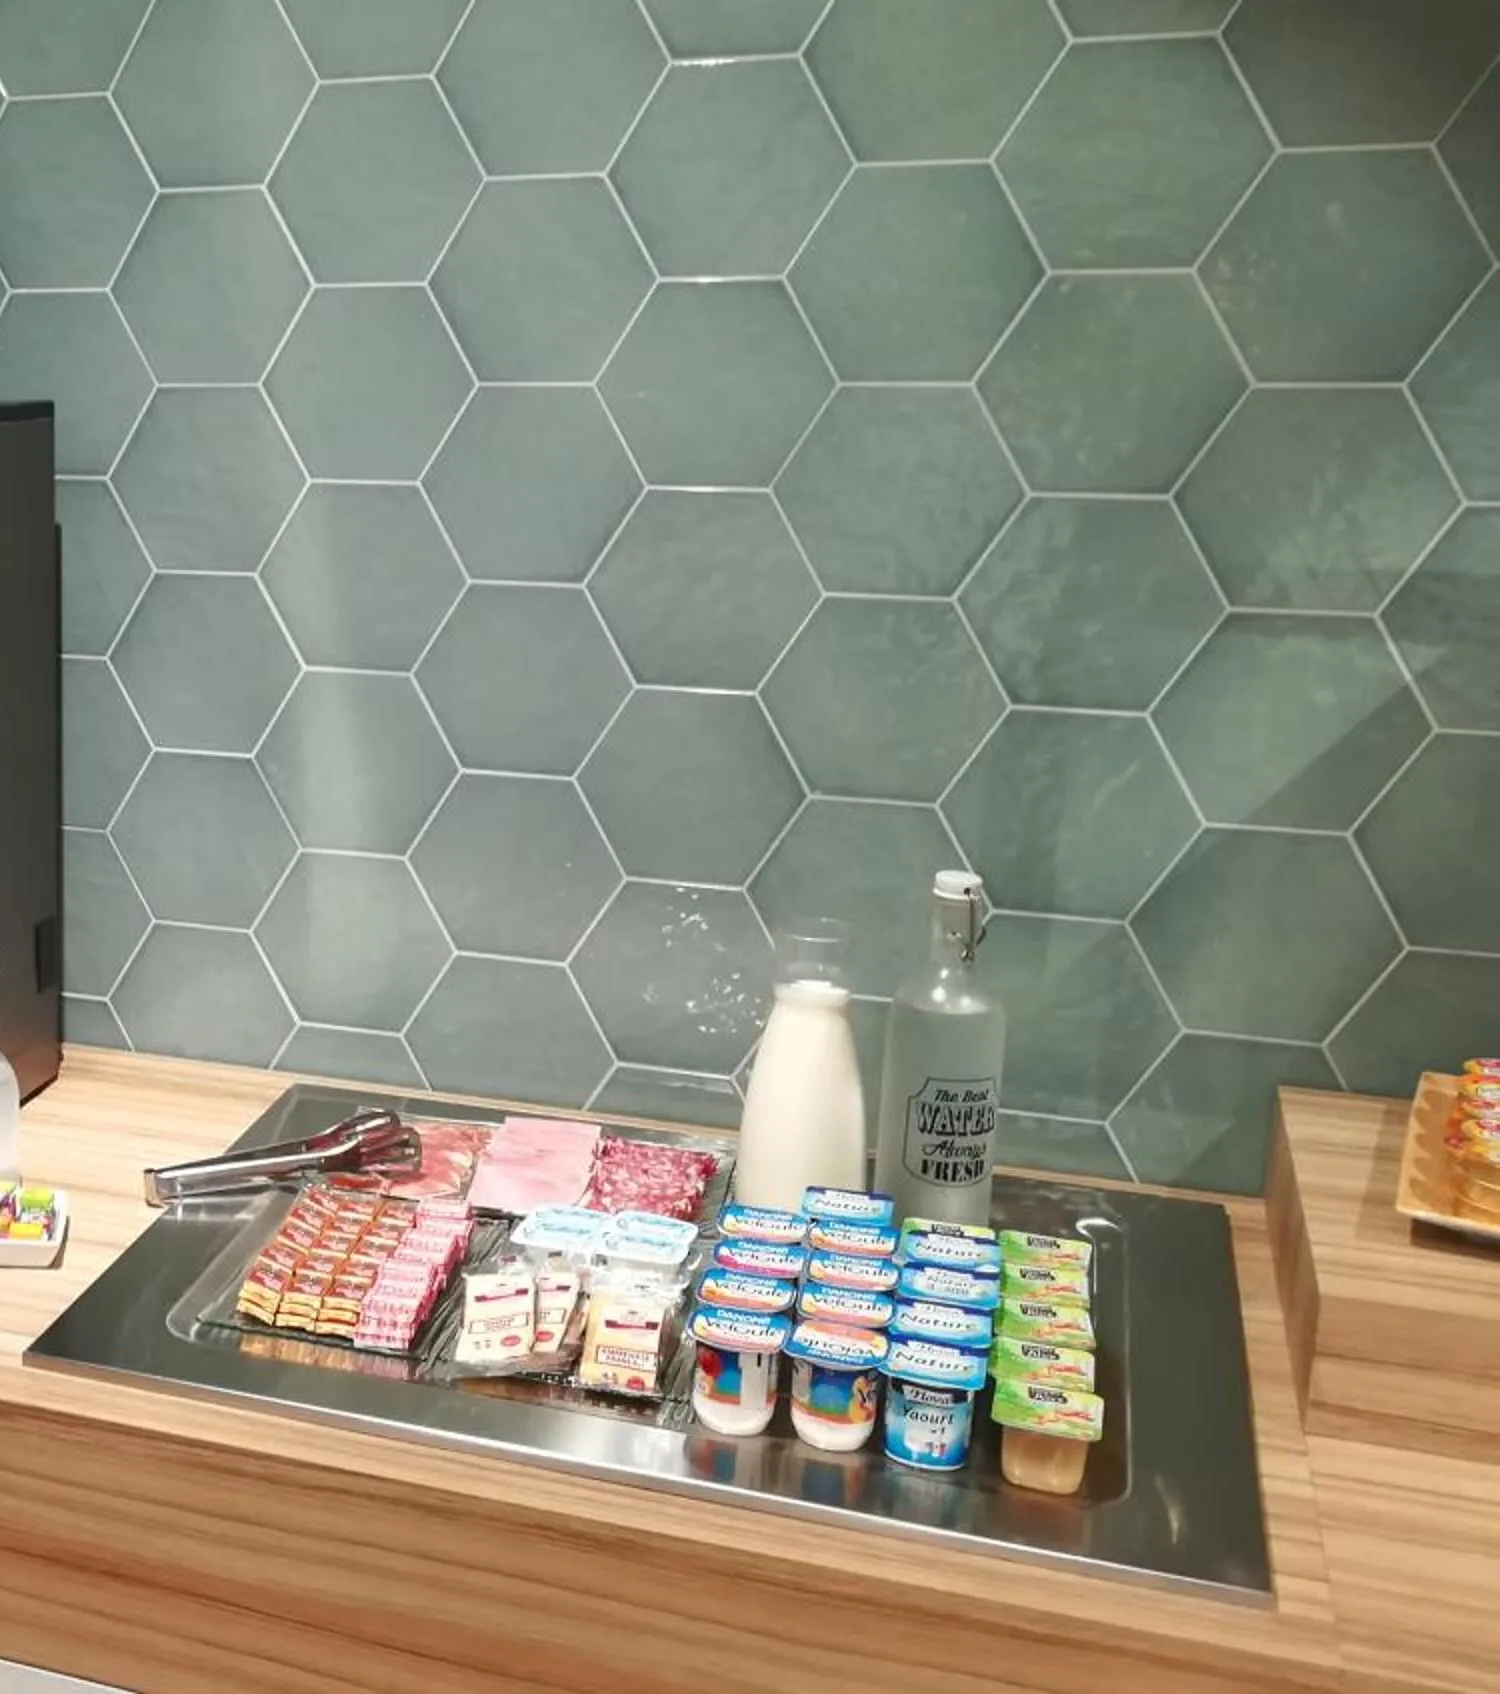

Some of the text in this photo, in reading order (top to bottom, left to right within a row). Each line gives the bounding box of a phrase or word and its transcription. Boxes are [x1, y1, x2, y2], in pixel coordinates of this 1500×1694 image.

[934, 1089, 958, 1102] The
[917, 1103, 995, 1136] WATER
[921, 1160, 984, 1182] FRESH
[717, 1309, 770, 1325] DANONE
[900, 1313, 976, 1330] Nature
[896, 1351, 974, 1372] Nature
[904, 1404, 954, 1424] Yaourt
